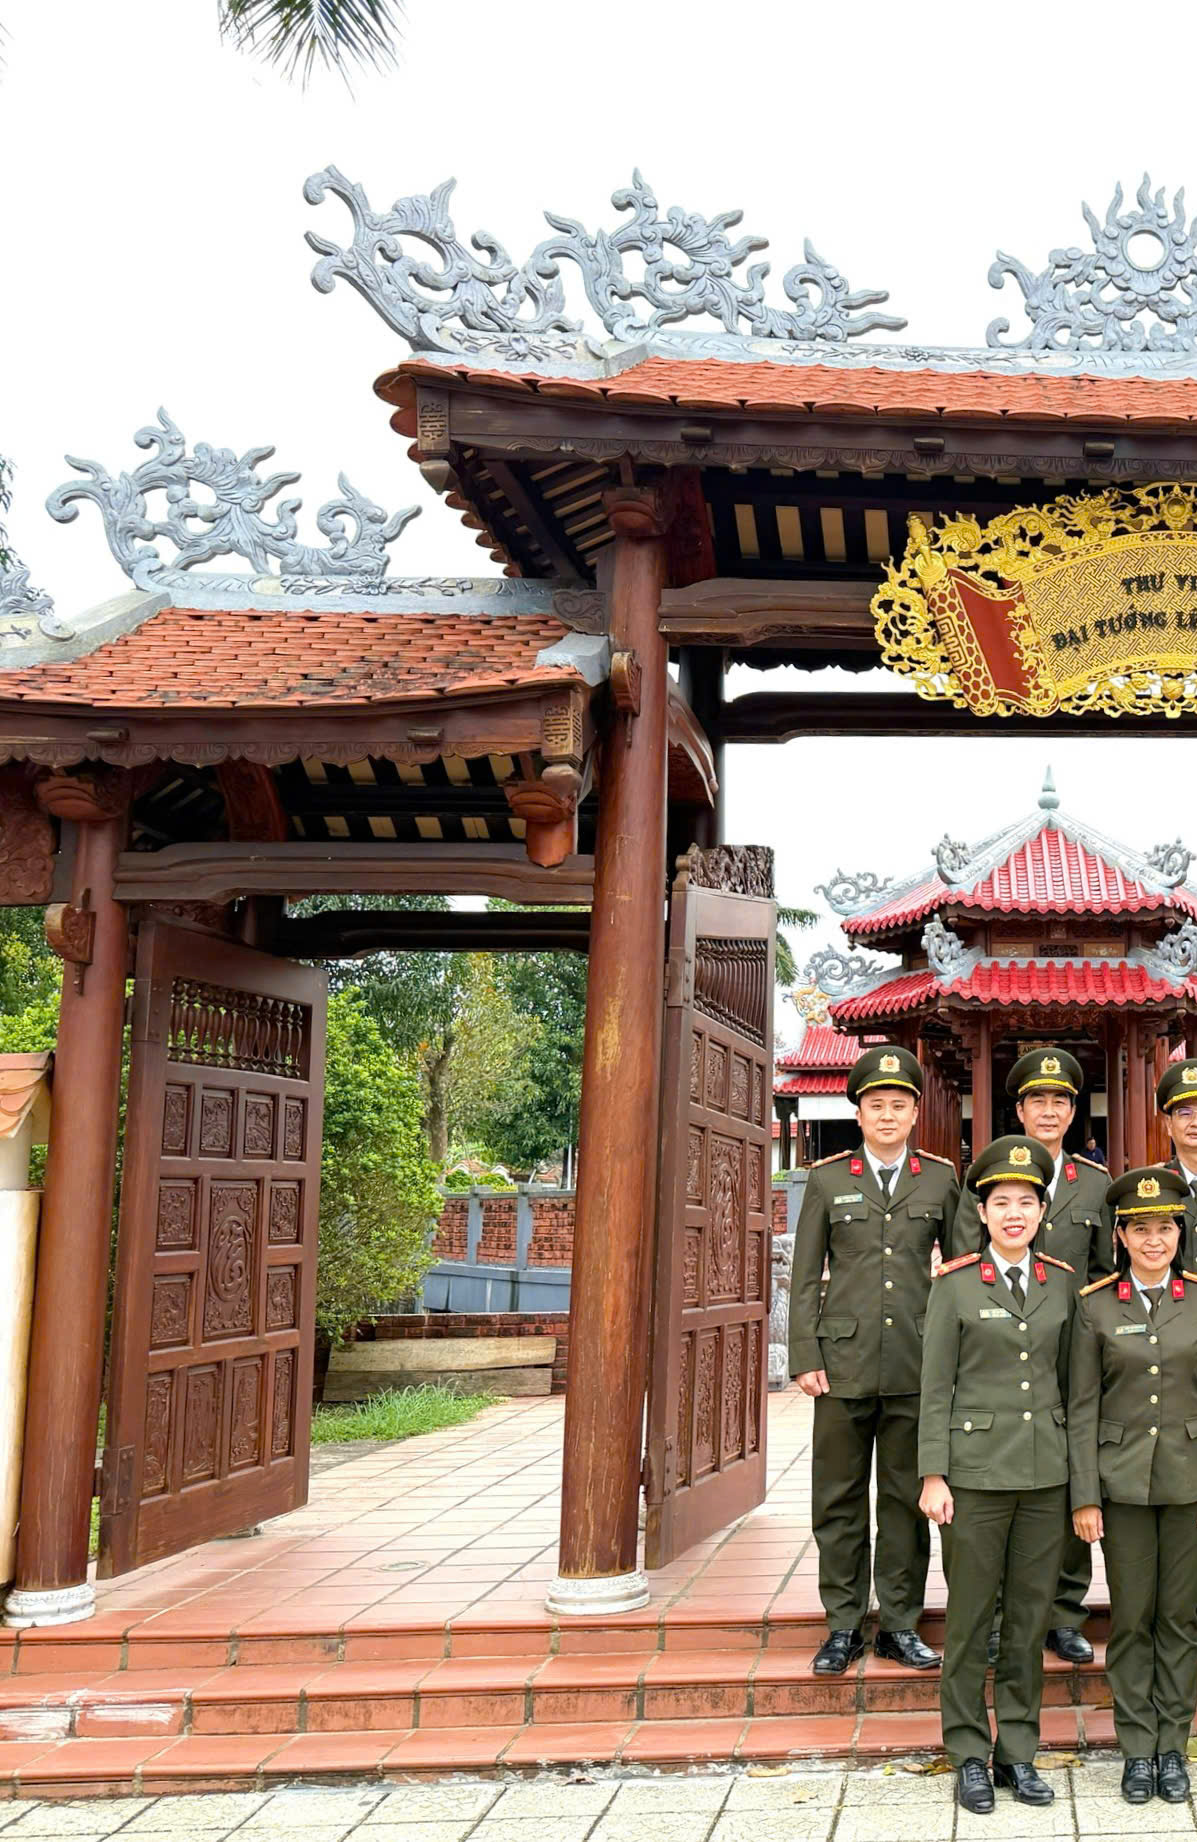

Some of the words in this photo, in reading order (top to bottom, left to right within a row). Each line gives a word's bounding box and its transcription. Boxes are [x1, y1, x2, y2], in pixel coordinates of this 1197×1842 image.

[1121, 571, 1165, 595] THƯ
[1051, 625, 1089, 652] ĐẠI
[1095, 603, 1167, 640] TƯỚNG
